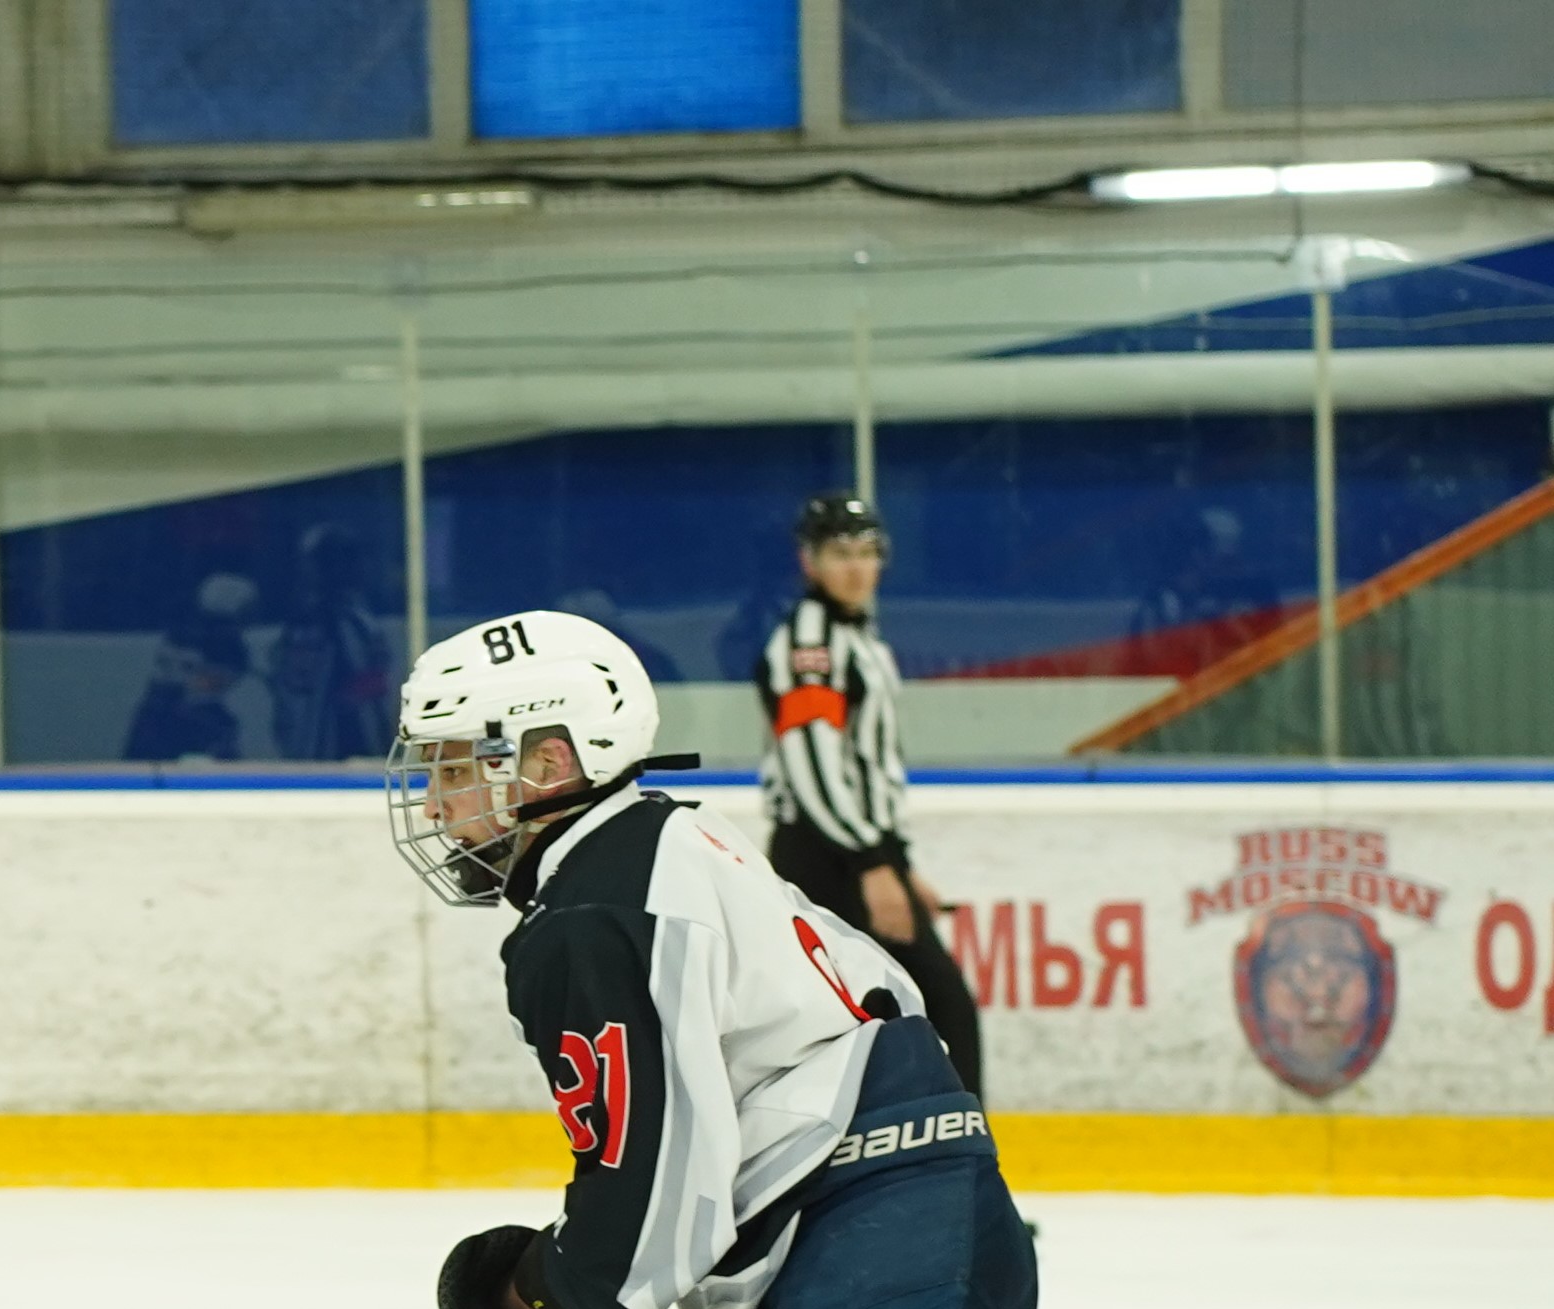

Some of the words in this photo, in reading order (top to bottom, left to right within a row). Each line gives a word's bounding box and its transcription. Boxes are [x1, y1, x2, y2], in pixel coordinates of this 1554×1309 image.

[482, 620, 535, 665] 81
[508, 697, 565, 715] CCM
[1188, 868, 1444, 927] MOSCOW
[953, 903, 1146, 1010] МЬЯ
[829, 1111, 988, 1167] BAUER
